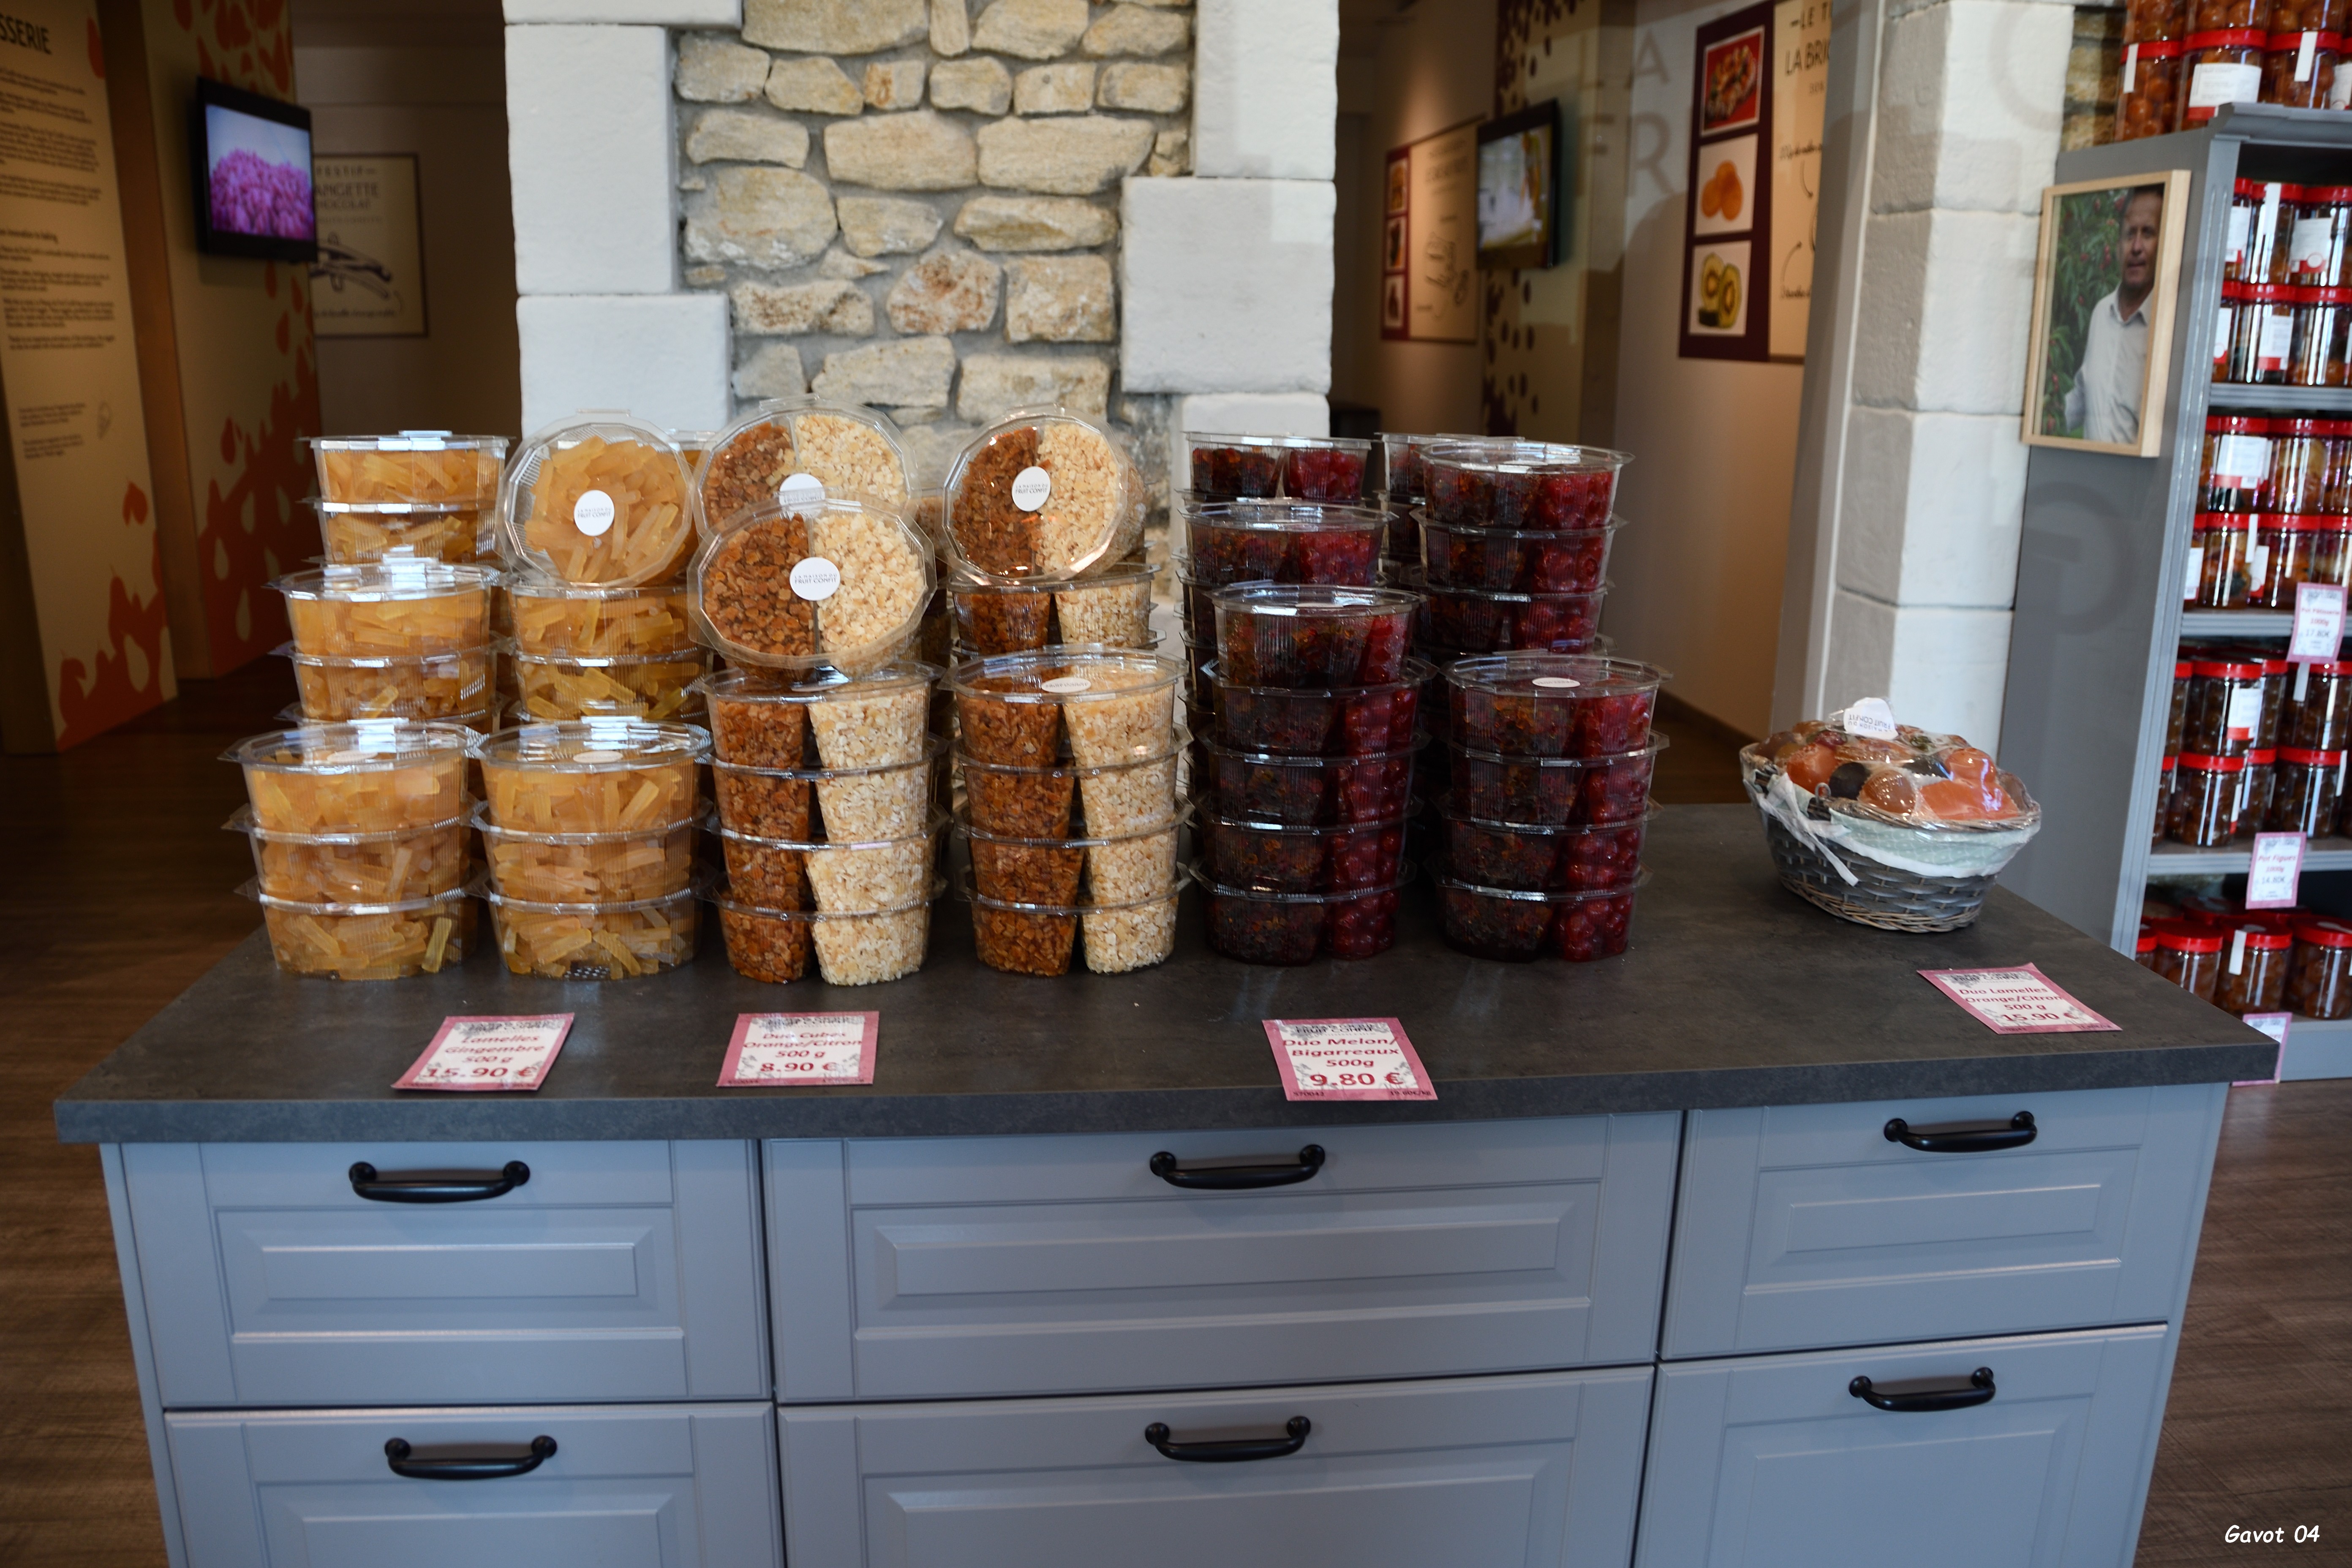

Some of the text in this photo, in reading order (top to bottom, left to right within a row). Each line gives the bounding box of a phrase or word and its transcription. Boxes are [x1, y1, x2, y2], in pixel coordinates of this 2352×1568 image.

[1875, 719, 1891, 730] FRUIT
[2001, 1013, 2060, 1021] 15.90
[462, 1035, 539, 1043] Lamelles
[1328, 1036, 1399, 1046] Melon/
[743, 1040, 862, 1049] Orange/Citron
[445, 1045, 545, 1054] Gingembre
[1292, 1048, 1399, 1057] Bigarreaux
[760, 1062, 814, 1072] 8.90
[1326, 1059, 1375, 1068] 500g
[424, 1066, 538, 1078] 15.90 €
[1310, 1073, 1404, 1086] 9.80 €
